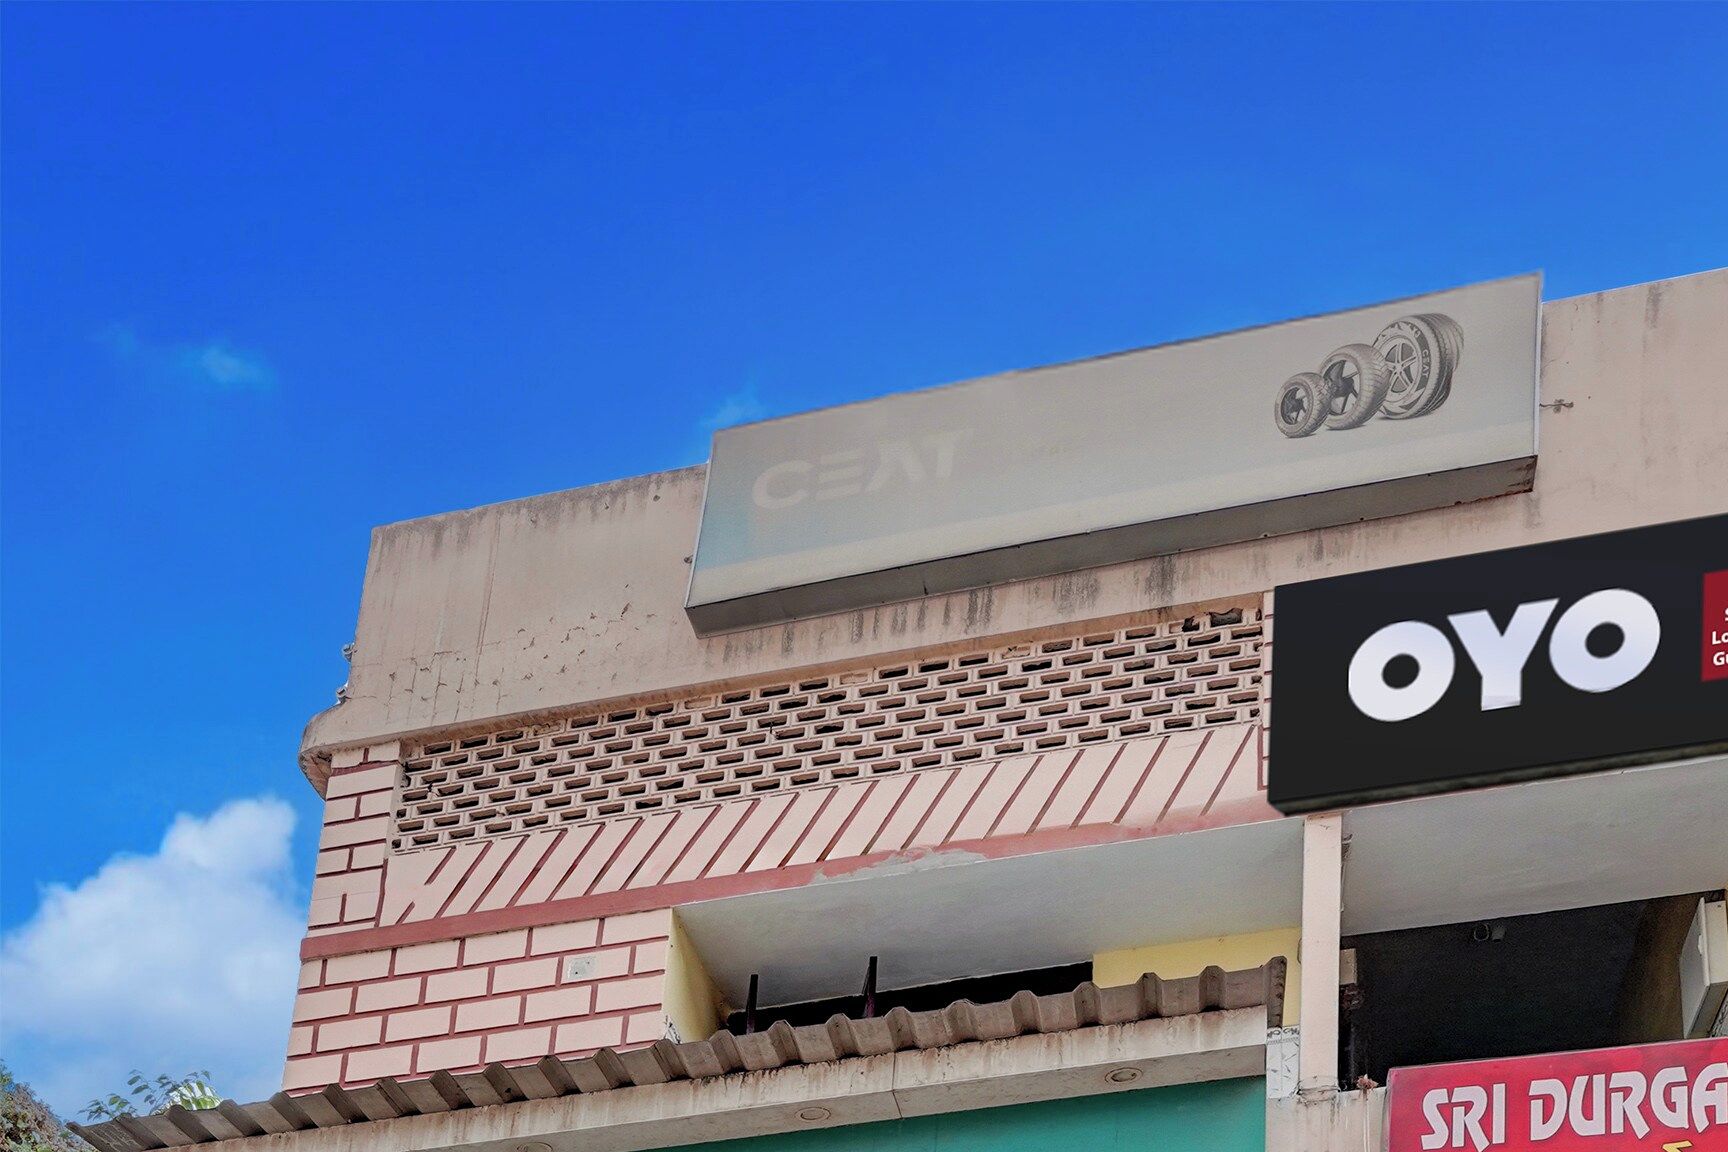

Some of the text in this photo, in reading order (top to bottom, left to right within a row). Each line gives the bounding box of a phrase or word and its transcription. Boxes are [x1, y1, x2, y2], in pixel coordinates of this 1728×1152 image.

[752, 429, 976, 509] CEAT
[1348, 588, 1660, 722] OYO
[1420, 1083, 1506, 1152] SRI
